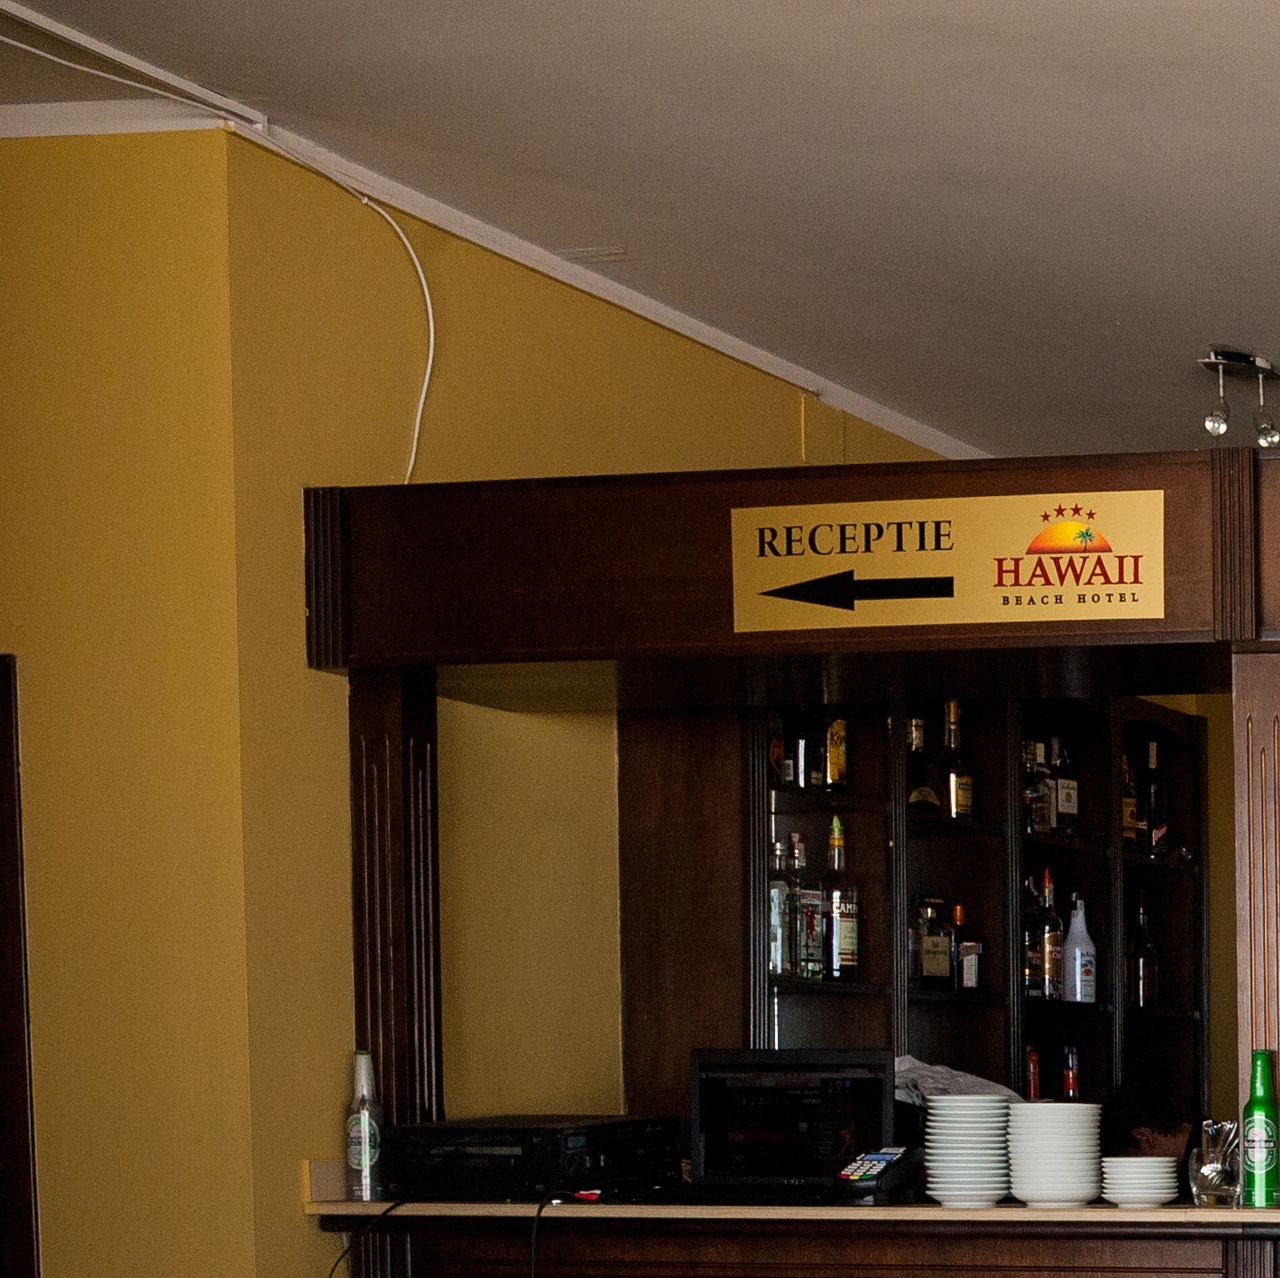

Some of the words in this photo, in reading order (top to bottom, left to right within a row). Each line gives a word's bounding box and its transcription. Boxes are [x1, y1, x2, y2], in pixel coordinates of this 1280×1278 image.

[756, 520, 955, 558] RECEPTIE
[993, 554, 1144, 588] HAWAII
[1002, 594, 1064, 606] BEACH
[1077, 592, 1140, 604] HOTEL
